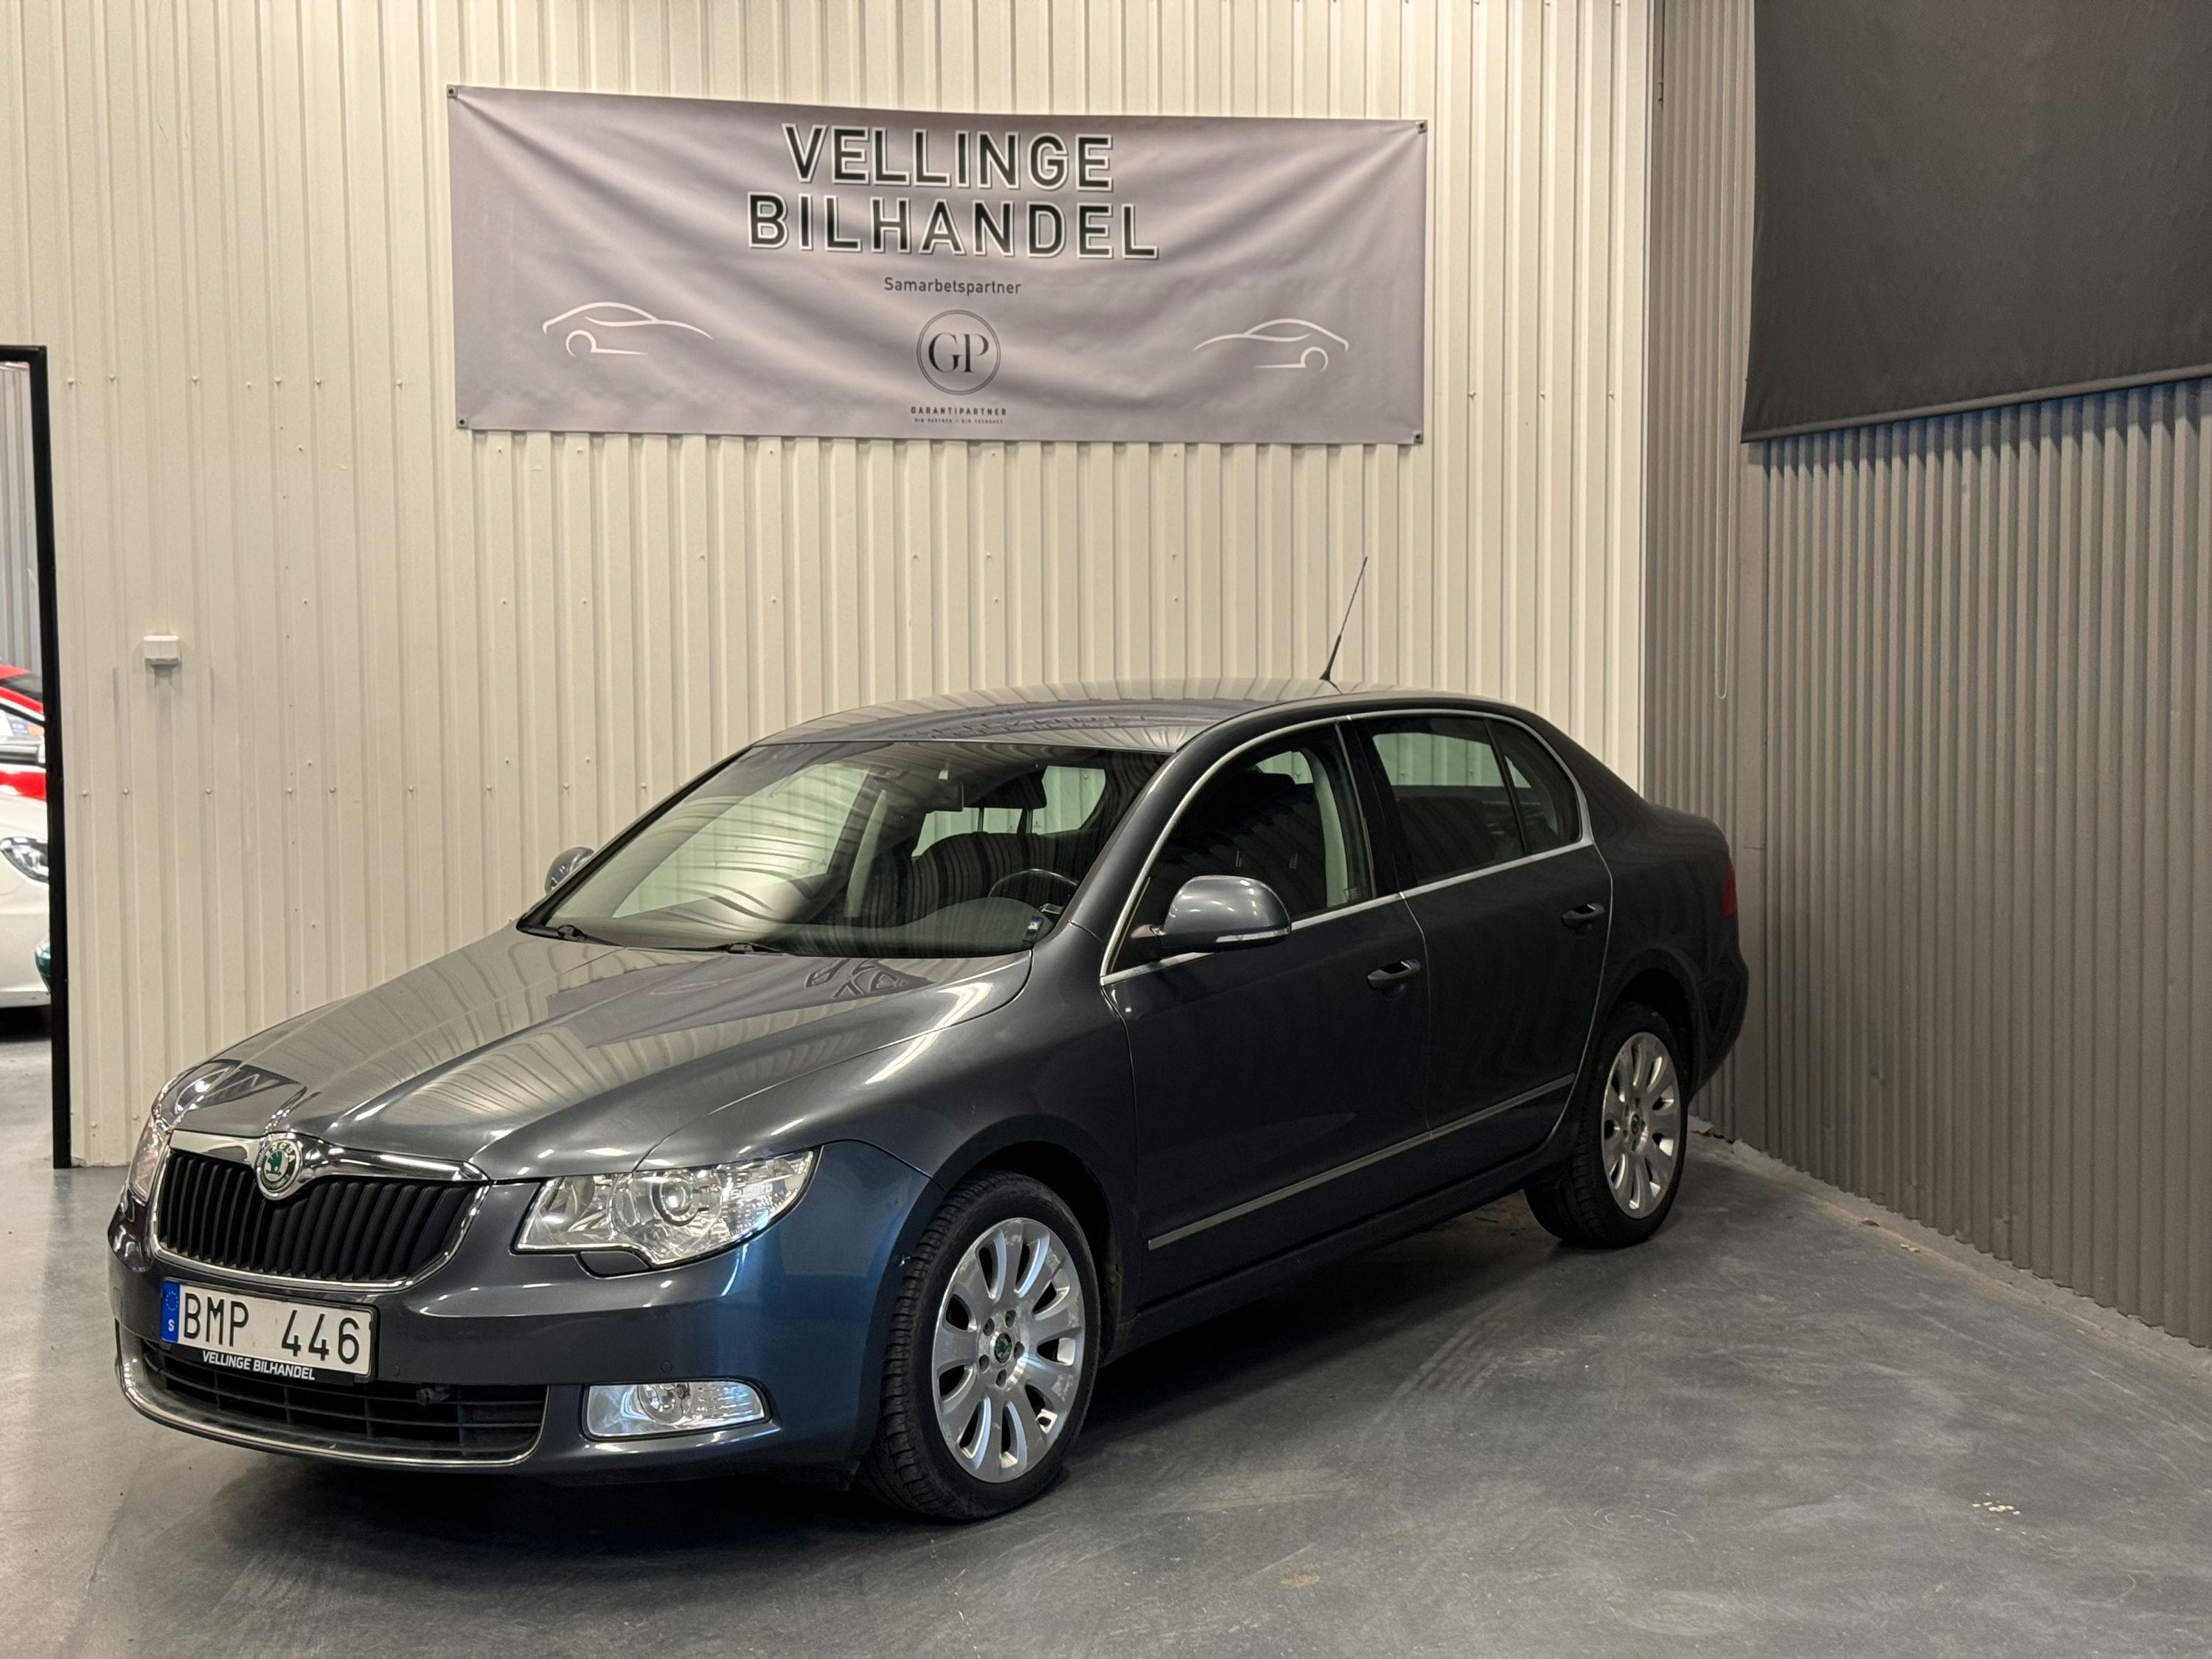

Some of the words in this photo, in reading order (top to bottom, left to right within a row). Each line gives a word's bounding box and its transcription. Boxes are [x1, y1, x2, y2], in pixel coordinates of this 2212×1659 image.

[782, 123, 1113, 192] VELLINGE
[748, 192, 1158, 260] BILHANDEL
[884, 276, 1022, 296] Samarbetspartner
[928, 333, 989, 372] GP
[910, 406, 1006, 416] GARANTIPARTNER
[168, 1318, 175, 1332] S
[184, 1293, 249, 1347] BMP
[281, 1309, 360, 1365] 446
[203, 1350, 251, 1370] VELLINGE
[253, 1360, 316, 1380] BILHANDEL
